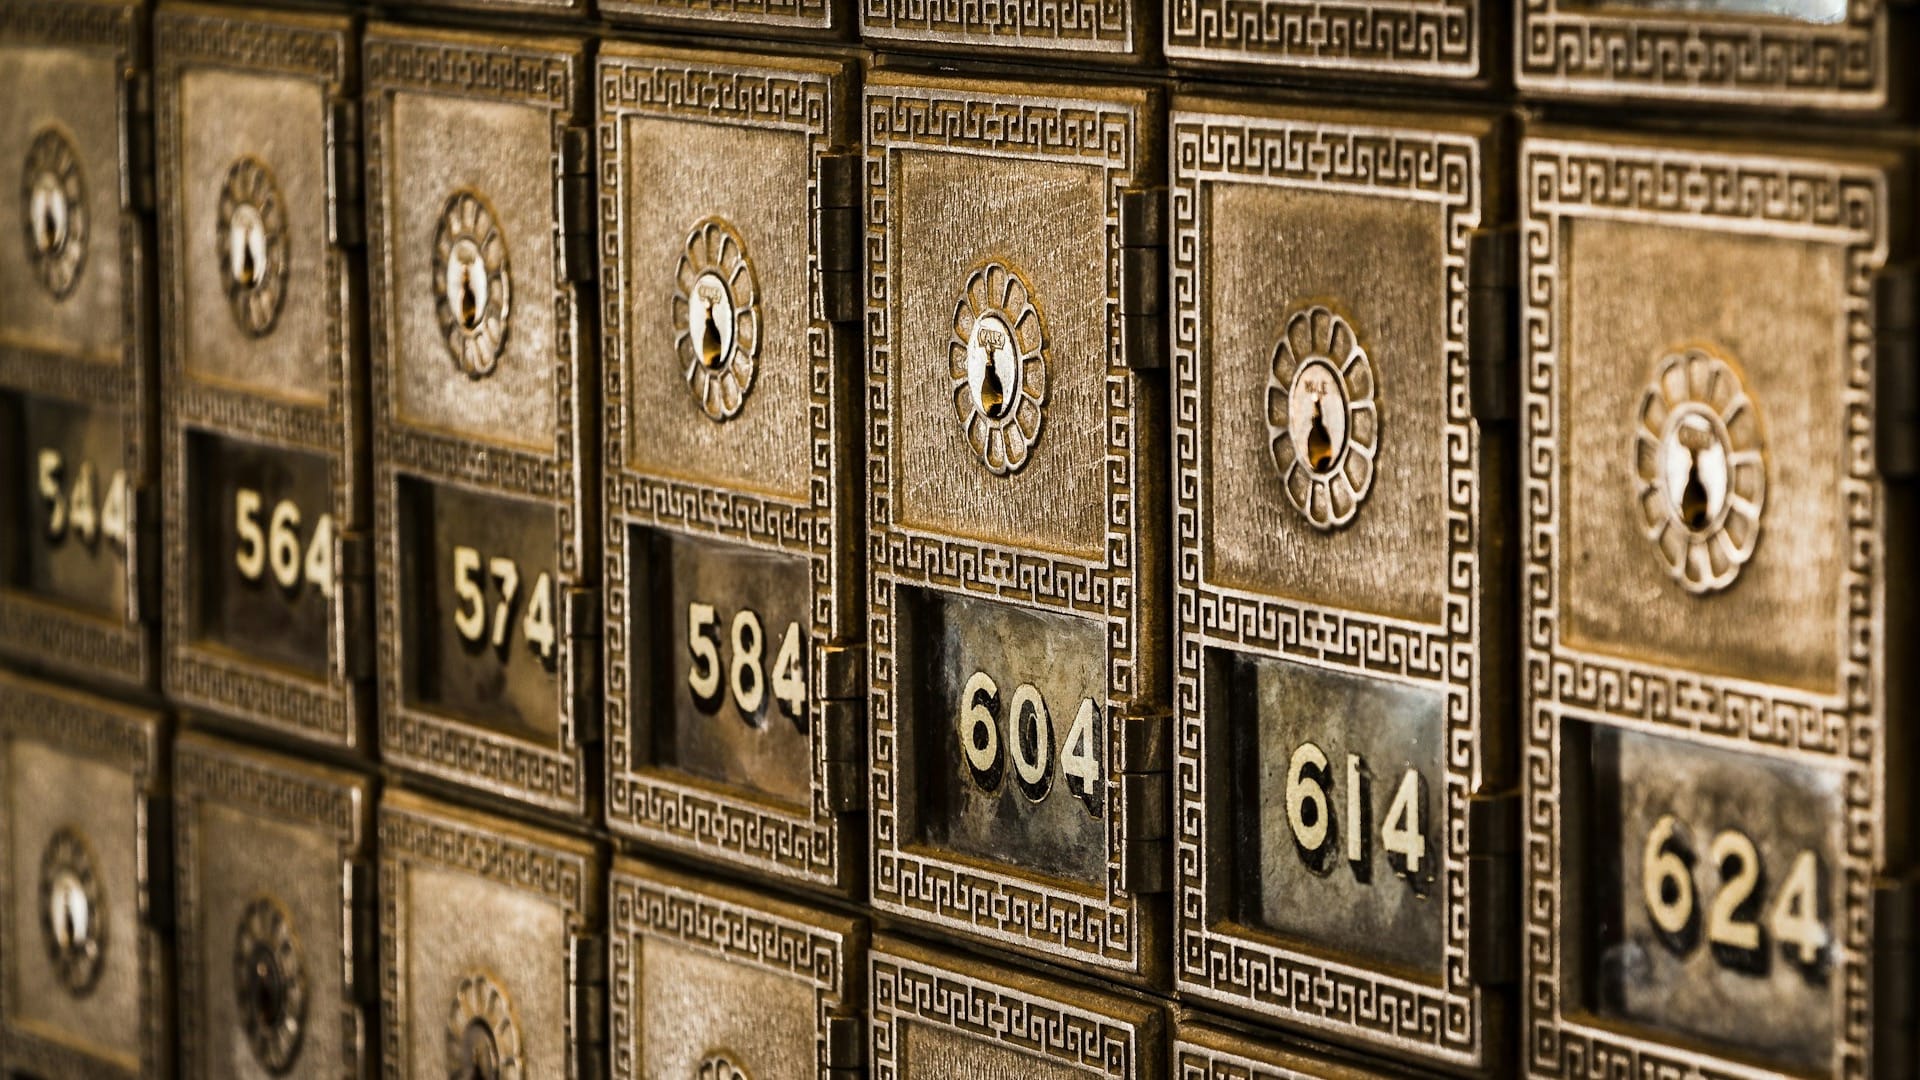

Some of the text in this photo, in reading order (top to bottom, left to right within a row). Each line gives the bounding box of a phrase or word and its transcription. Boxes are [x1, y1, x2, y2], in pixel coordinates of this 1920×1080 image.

[38, 448, 126, 543] 544
[235, 488, 334, 598] 564
[454, 545, 554, 657] 574
[688, 601, 806, 716] 584
[961, 671, 1100, 795] 604
[1286, 742, 1425, 872] 614
[1644, 815, 1826, 963] 624
